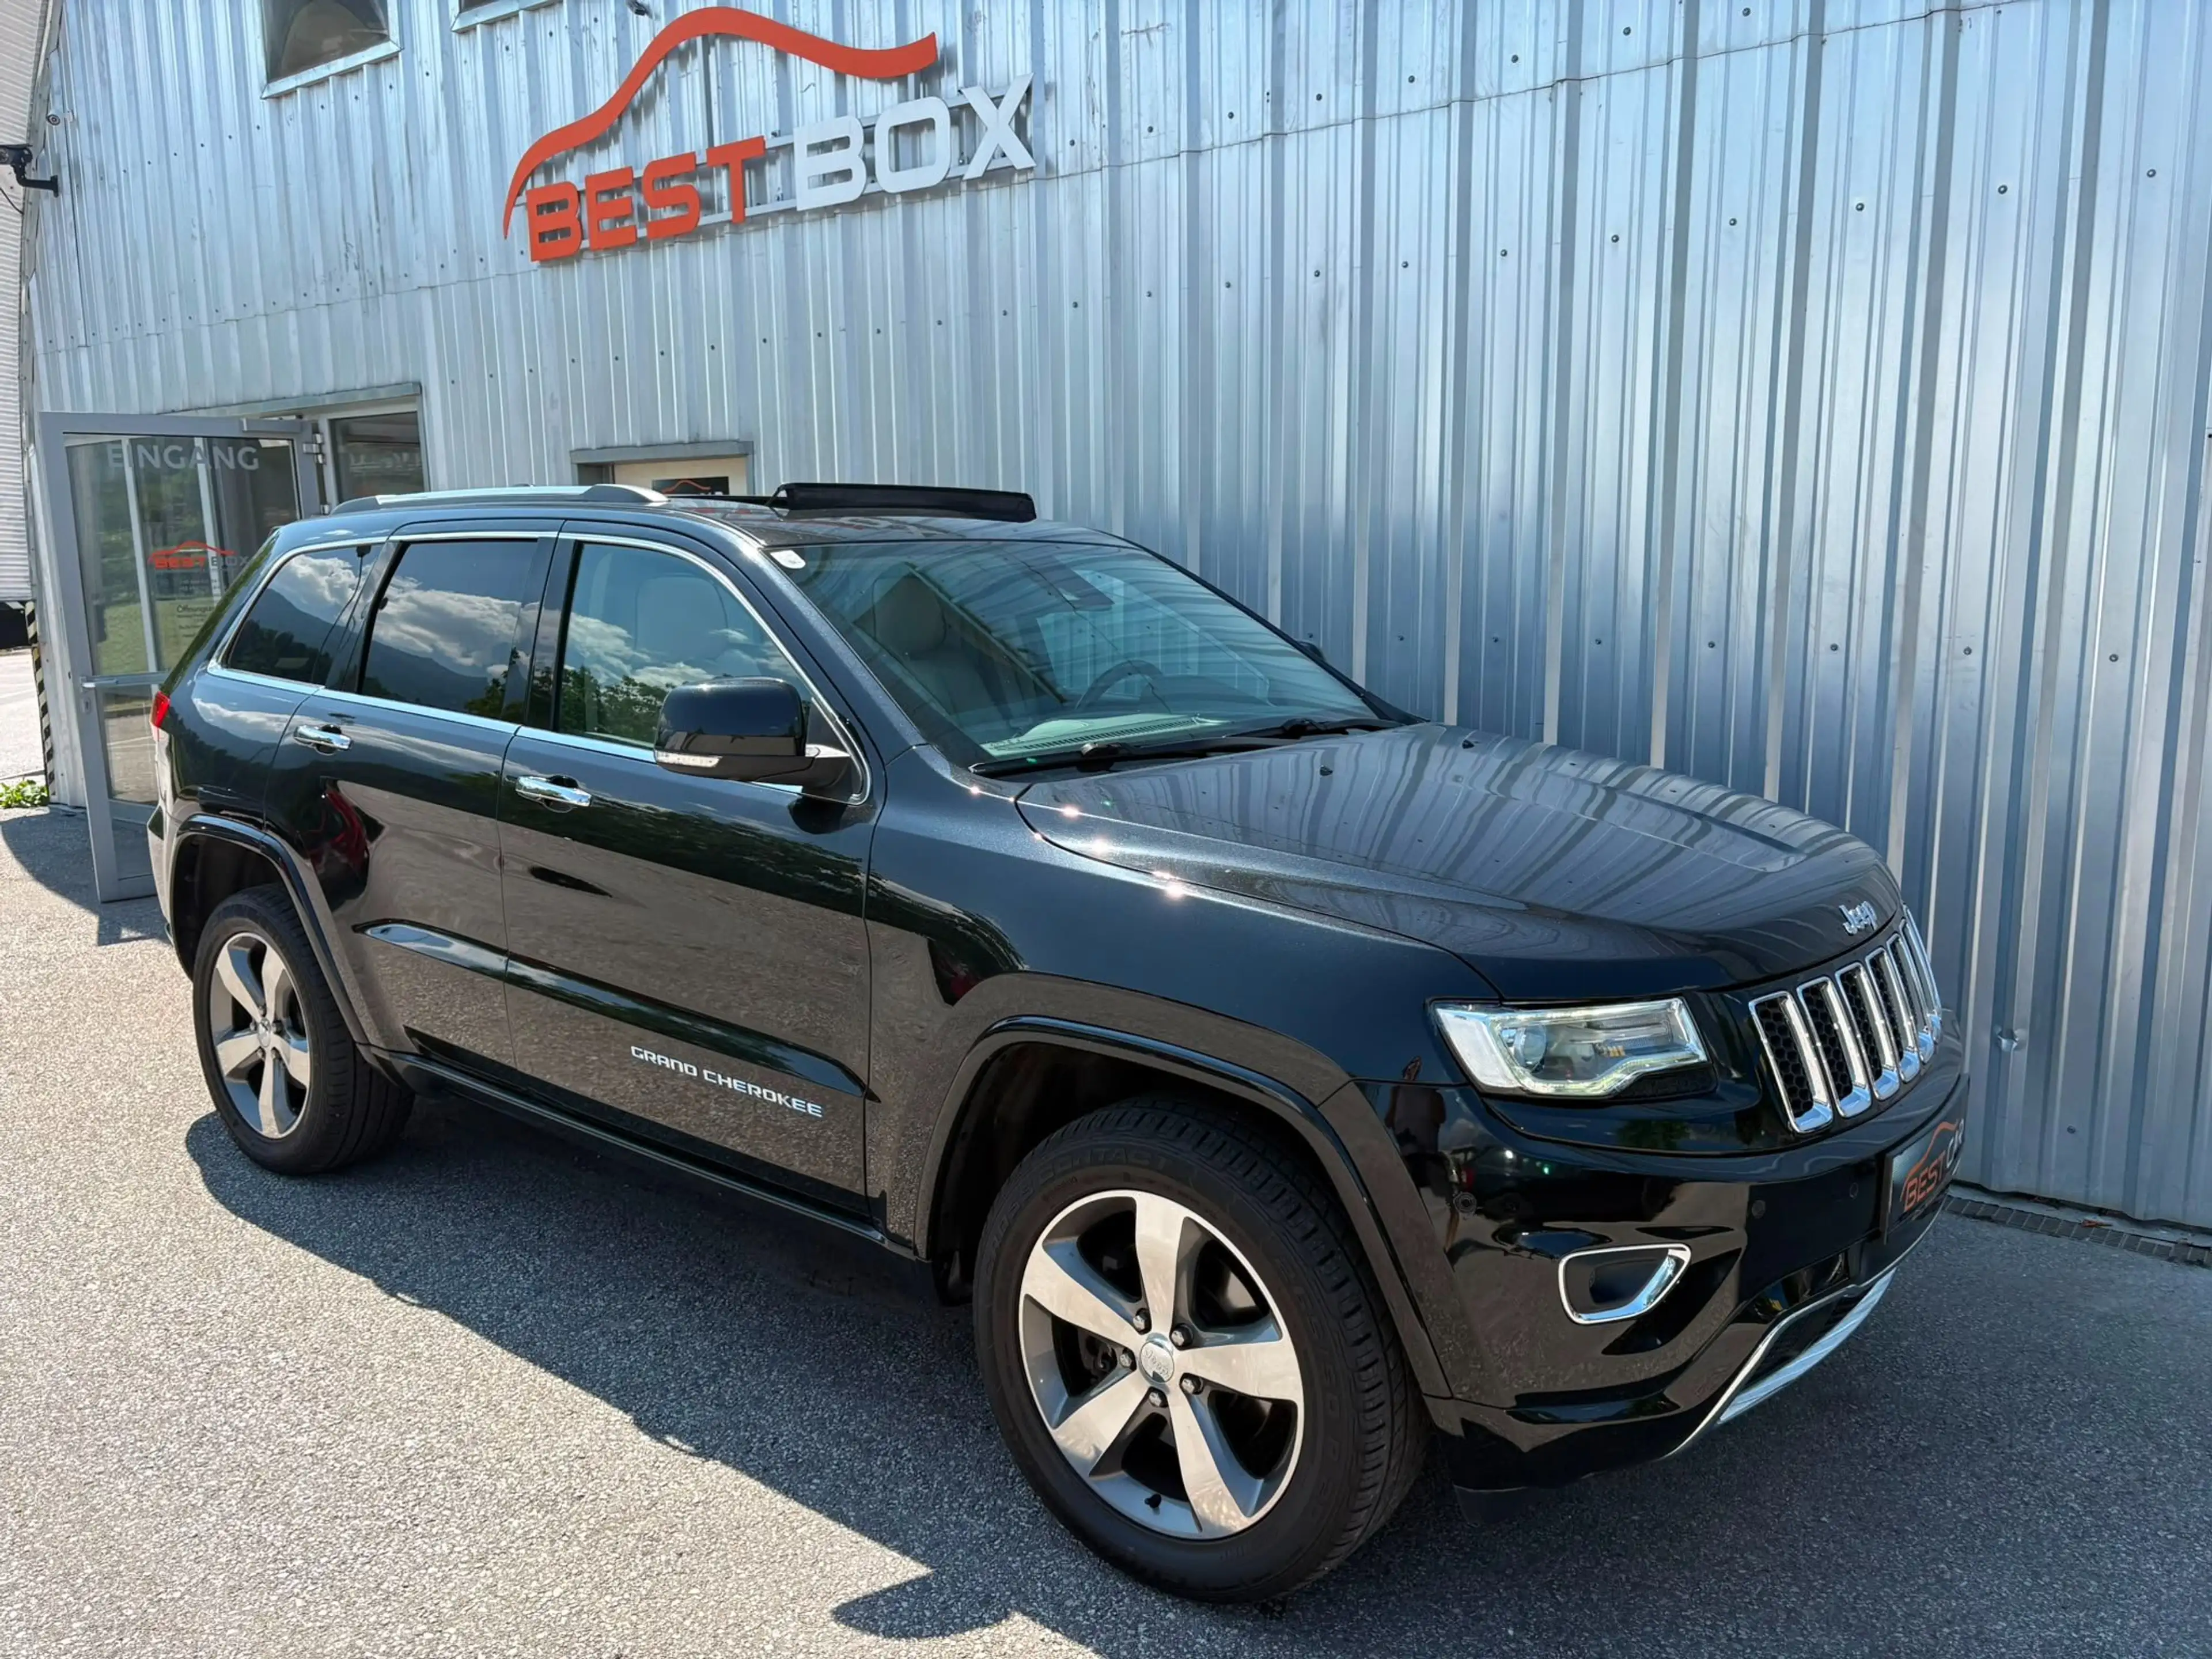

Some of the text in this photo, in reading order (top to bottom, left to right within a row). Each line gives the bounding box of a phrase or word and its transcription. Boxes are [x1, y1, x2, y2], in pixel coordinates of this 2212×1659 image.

[527, 72, 1037, 262] BEST BOX
[107, 444, 259, 470] EINGANG
[630, 1044, 823, 1118] GRAND CHEROKEE
[1903, 1149, 1946, 1213] BEST
